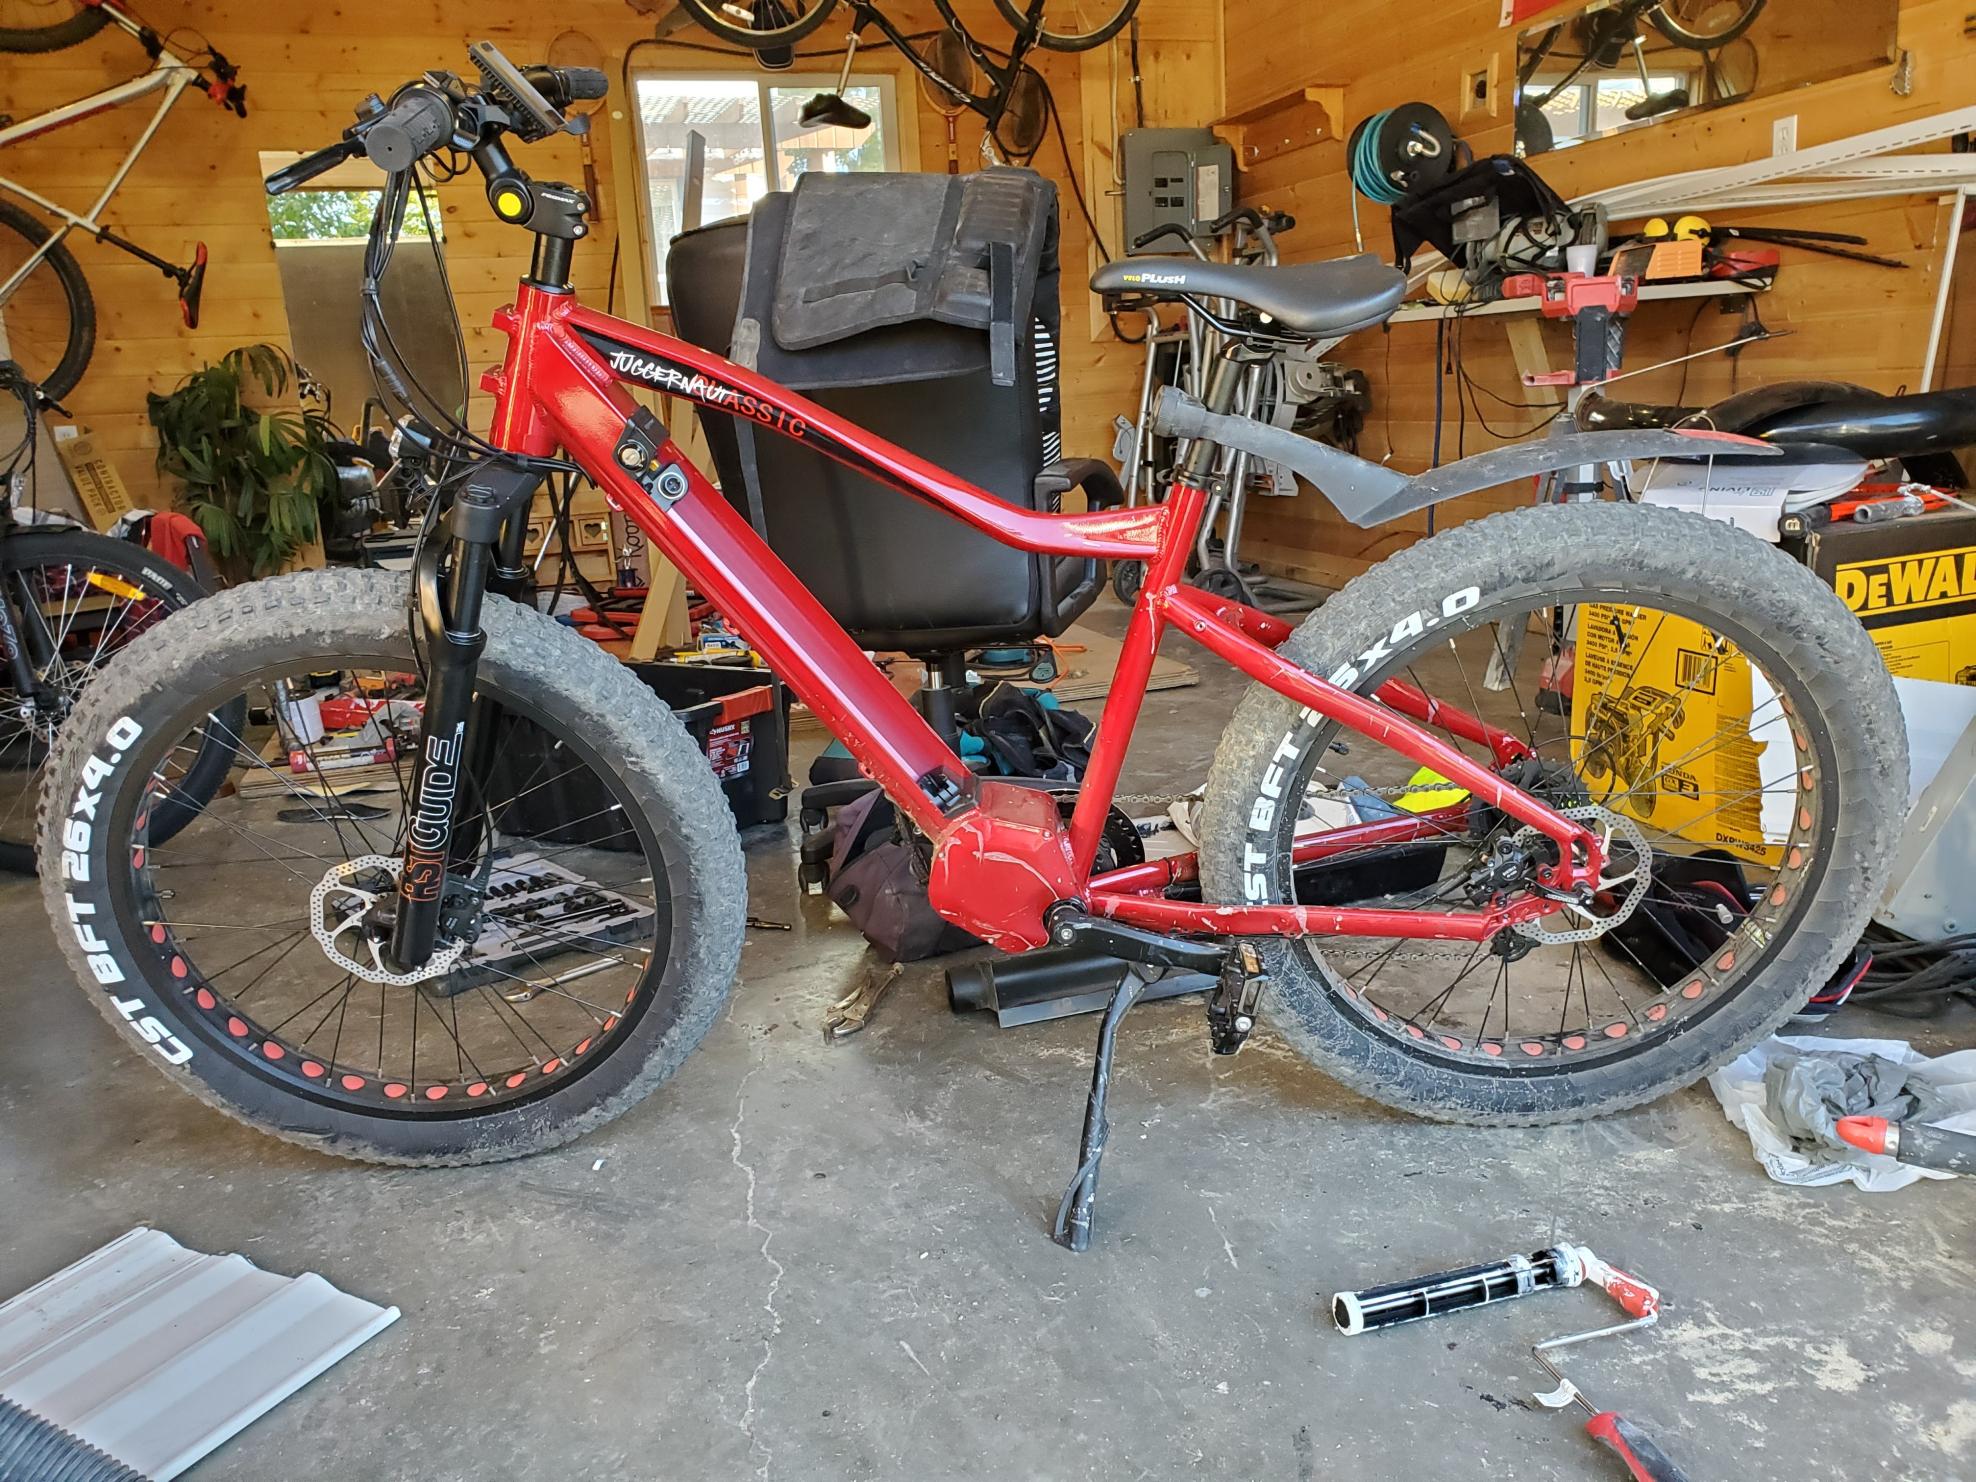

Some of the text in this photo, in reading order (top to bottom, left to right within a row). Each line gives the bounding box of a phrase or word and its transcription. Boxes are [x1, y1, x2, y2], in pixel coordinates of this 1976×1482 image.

[609, 351, 744, 402] JUGGERNAUT
[95, 459, 126, 511] CONTRACTOR
[716, 724, 736, 734] HUSKY
[407, 732, 463, 850] GUIDE
[1249, 731, 1300, 831] BFT
[1244, 842, 1268, 905] ST
[65, 892, 125, 984] BFT
[110, 994, 193, 1065] CST
